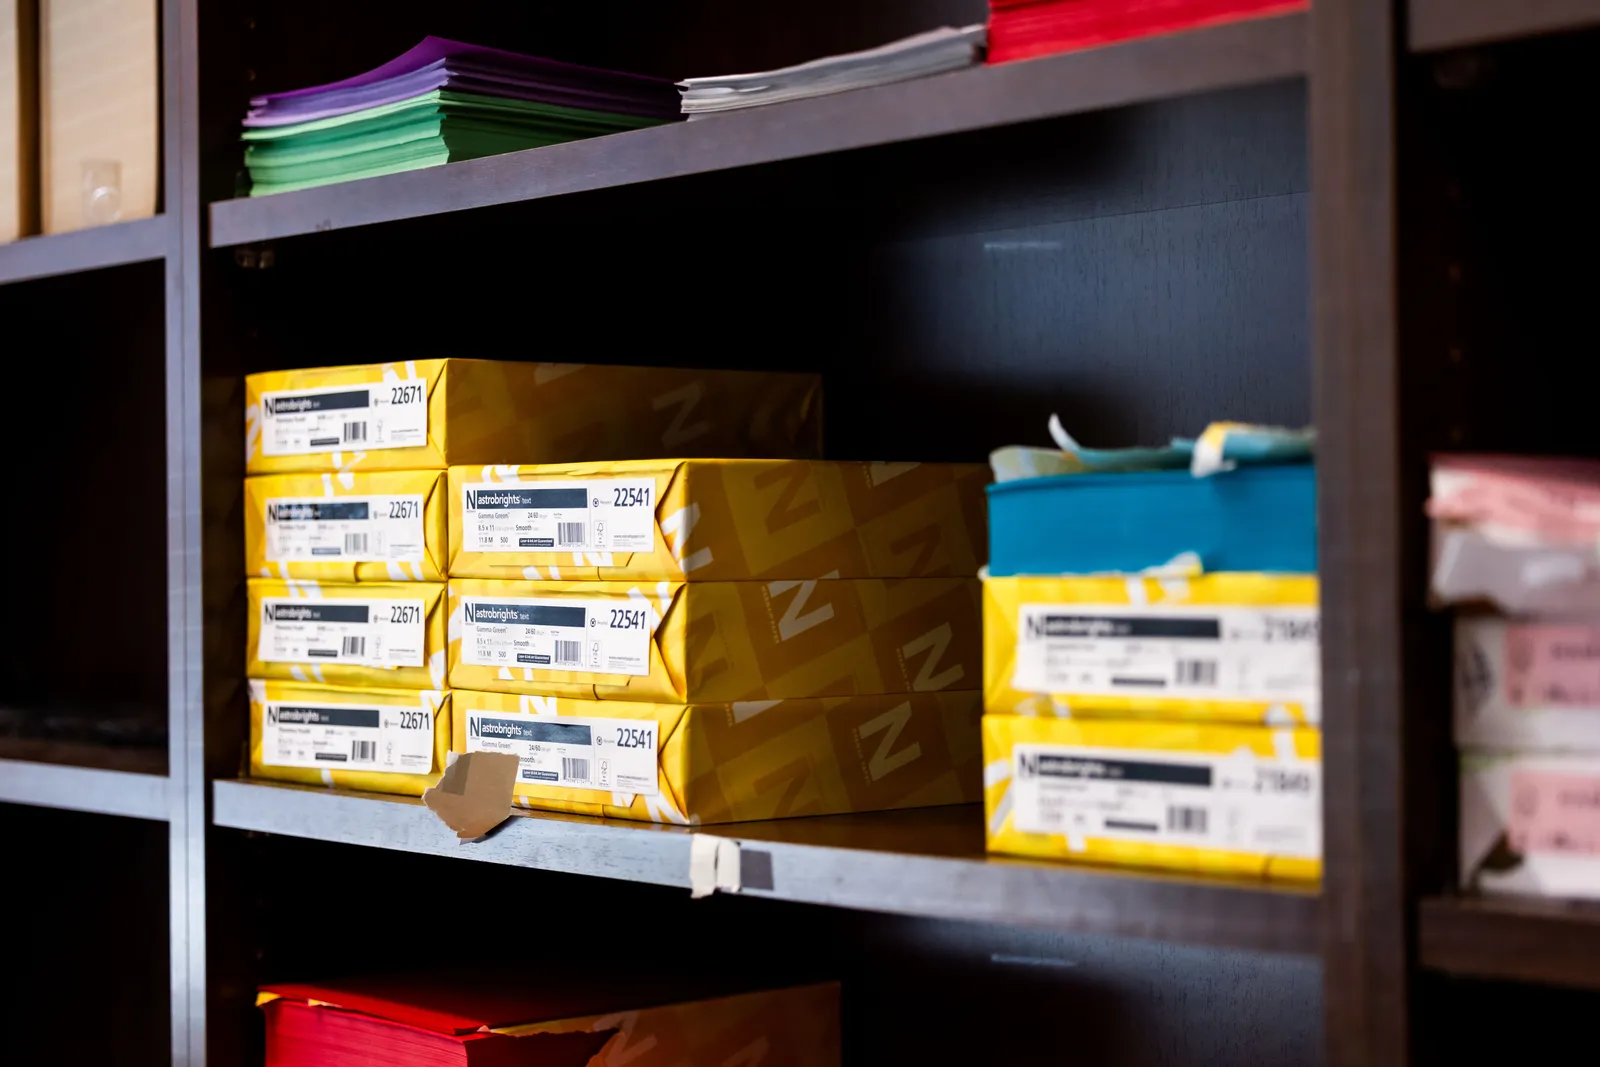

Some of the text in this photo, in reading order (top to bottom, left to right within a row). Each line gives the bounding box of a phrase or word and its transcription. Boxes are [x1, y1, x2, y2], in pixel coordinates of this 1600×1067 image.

[391, 386, 422, 405] 22671
[478, 493, 520, 507] astrobrights
[614, 488, 650, 507] 22541
[389, 501, 419, 519] 22671
[391, 606, 420, 624] 22671
[476, 607, 518, 622] astrobrights
[610, 609, 646, 629] 22541
[400, 711, 430, 730] 22671
[482, 723, 521, 737] astrobrights
[617, 728, 652, 749] 22541
